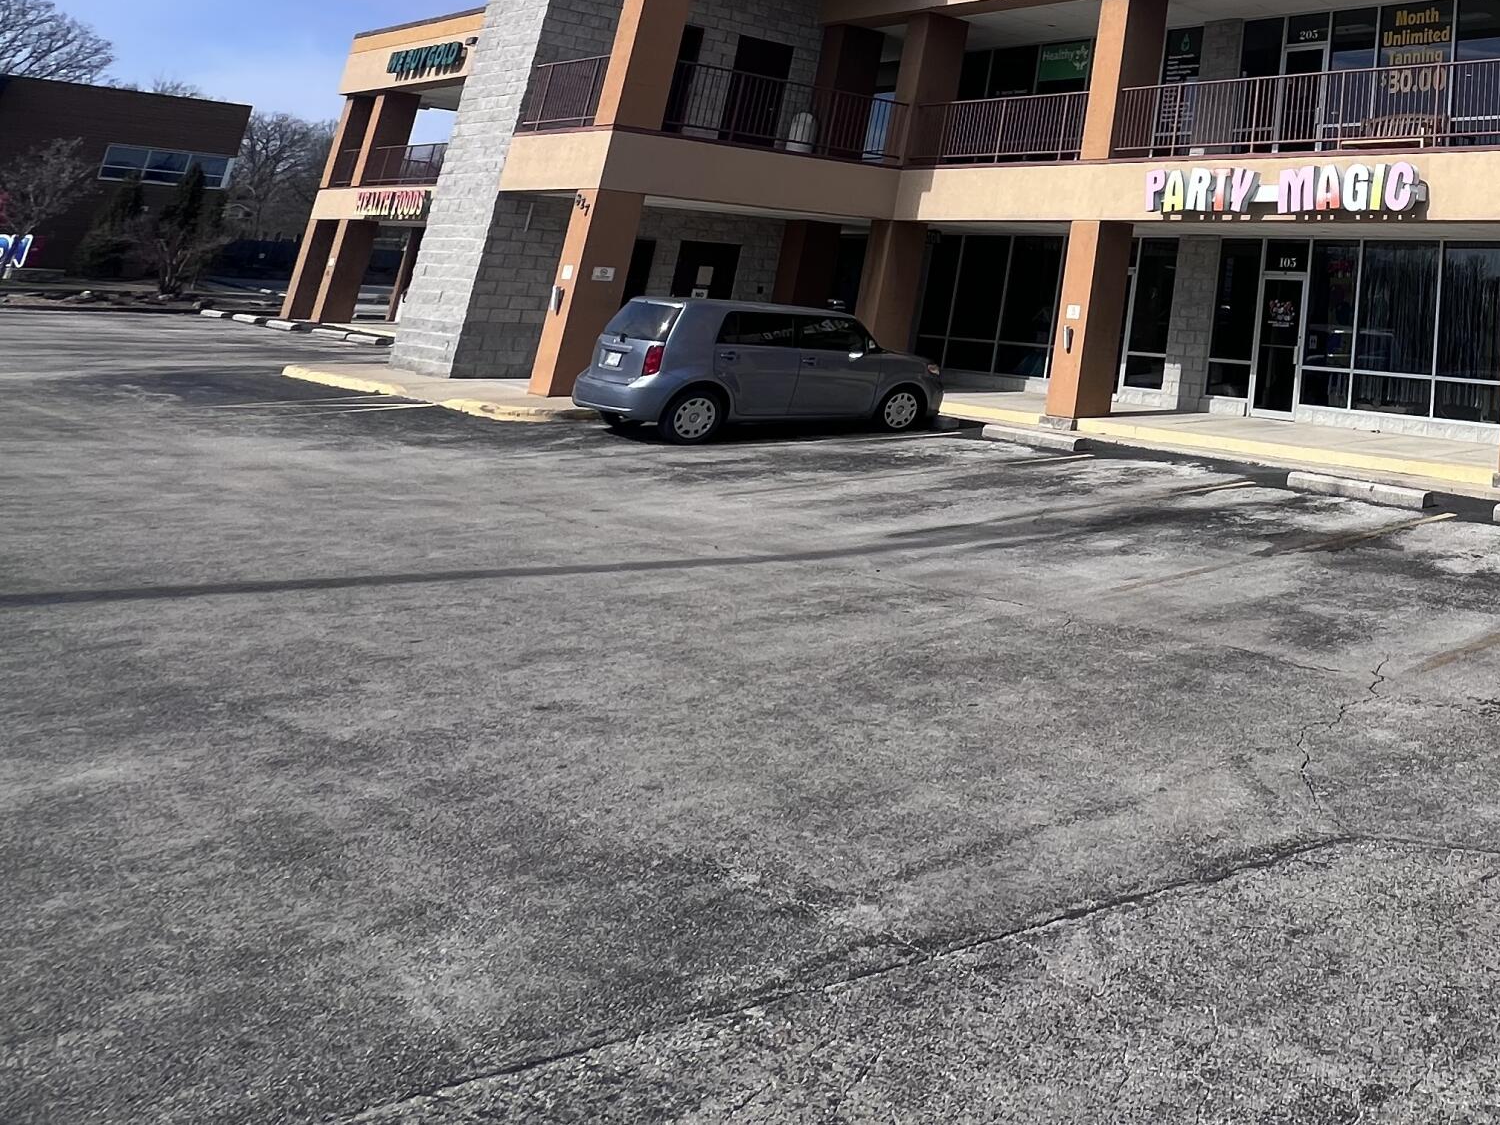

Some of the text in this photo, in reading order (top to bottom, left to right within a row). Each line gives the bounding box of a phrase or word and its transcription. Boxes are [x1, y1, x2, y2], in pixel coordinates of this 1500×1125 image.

[1395, 7, 1440, 27] Month
[1300, 29, 1318, 40] 205
[1383, 26, 1450, 47] Unlimited
[387, 41, 462, 73] WE BUY GOLD
[1042, 48, 1073, 62] Healthy
[1388, 47, 1443, 66] Tanning
[1145, 161, 1415, 214] PARTY MAGIC
[354, 190, 425, 217] HEALTH FOODS
[1280, 257, 1297, 268] 105
